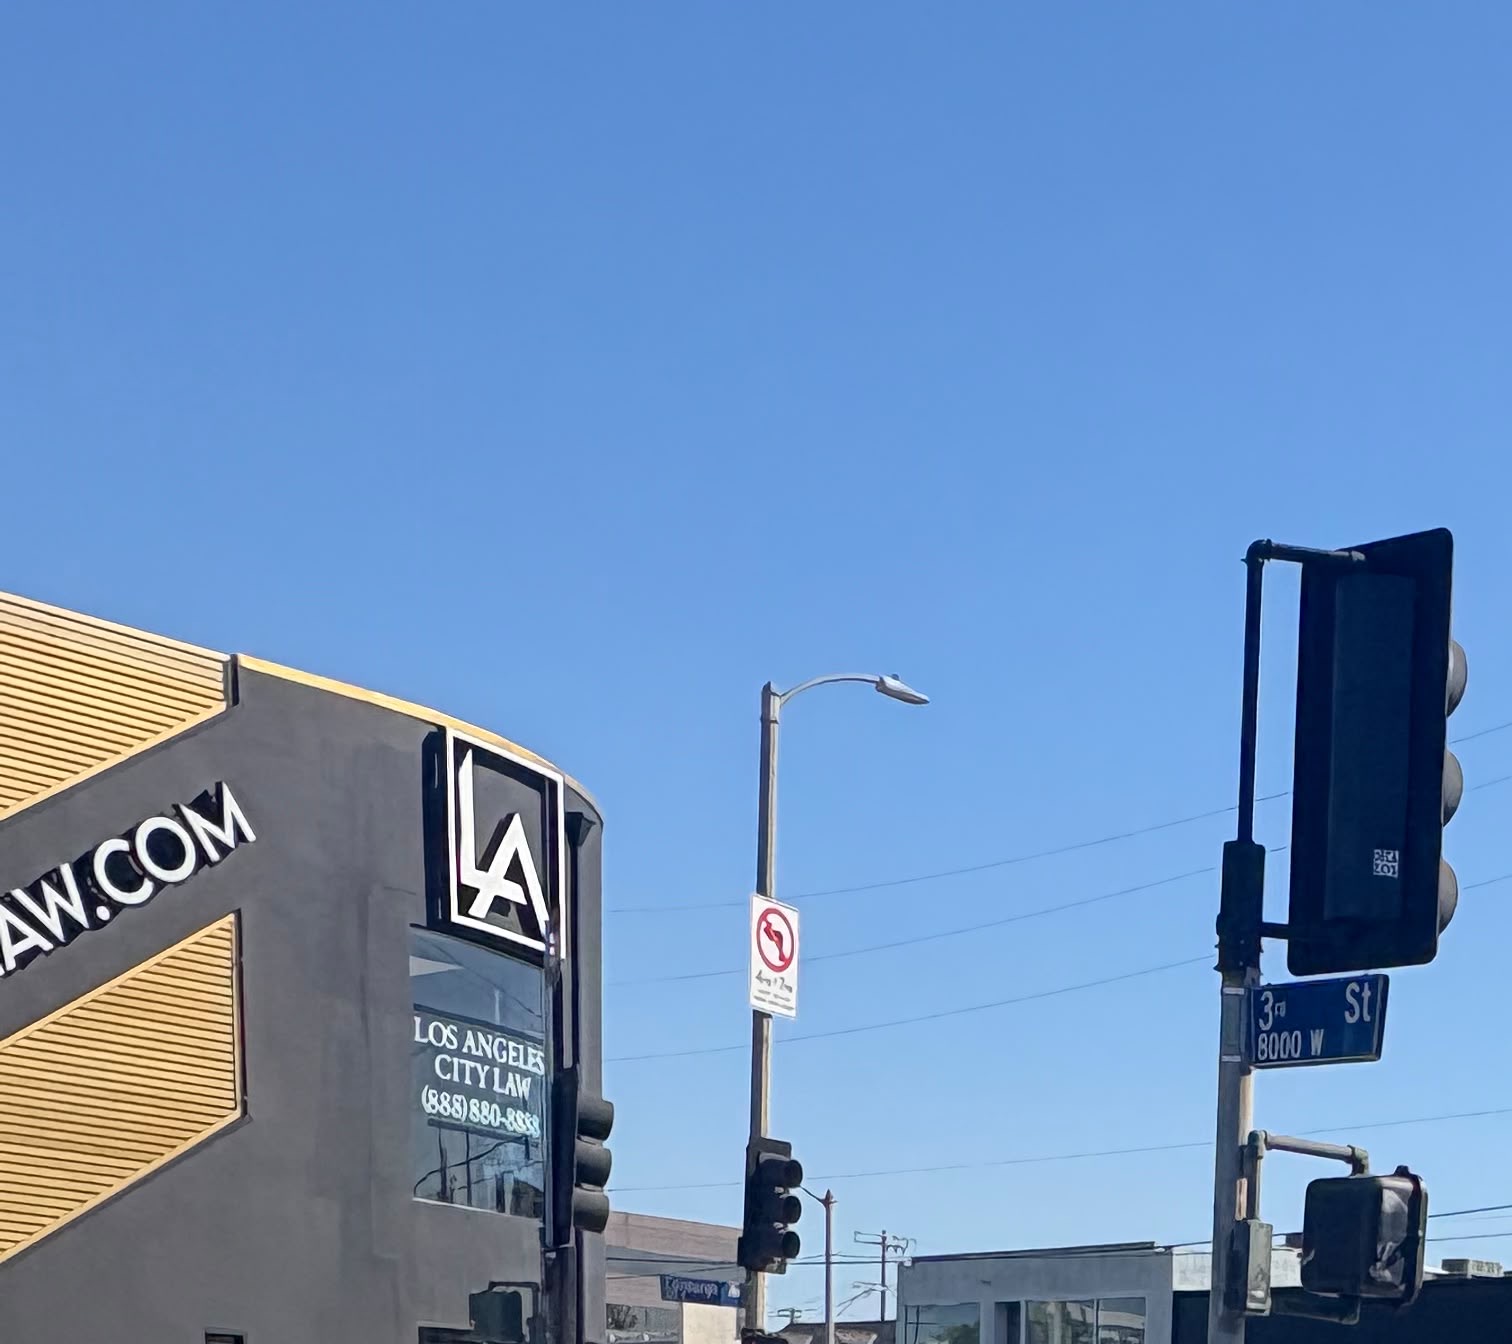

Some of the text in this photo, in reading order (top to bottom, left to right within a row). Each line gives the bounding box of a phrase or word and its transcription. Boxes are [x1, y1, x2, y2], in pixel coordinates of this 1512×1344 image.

[458, 748, 550, 937] LA
[0, 781, 256, 976] AW.COM
[1344, 981, 1371, 1024] St
[413, 1015, 545, 1076] LOS ANGELES
[1257, 1028, 1324, 1061] 8000 W
[434, 1054, 531, 1100] CITY LAW
